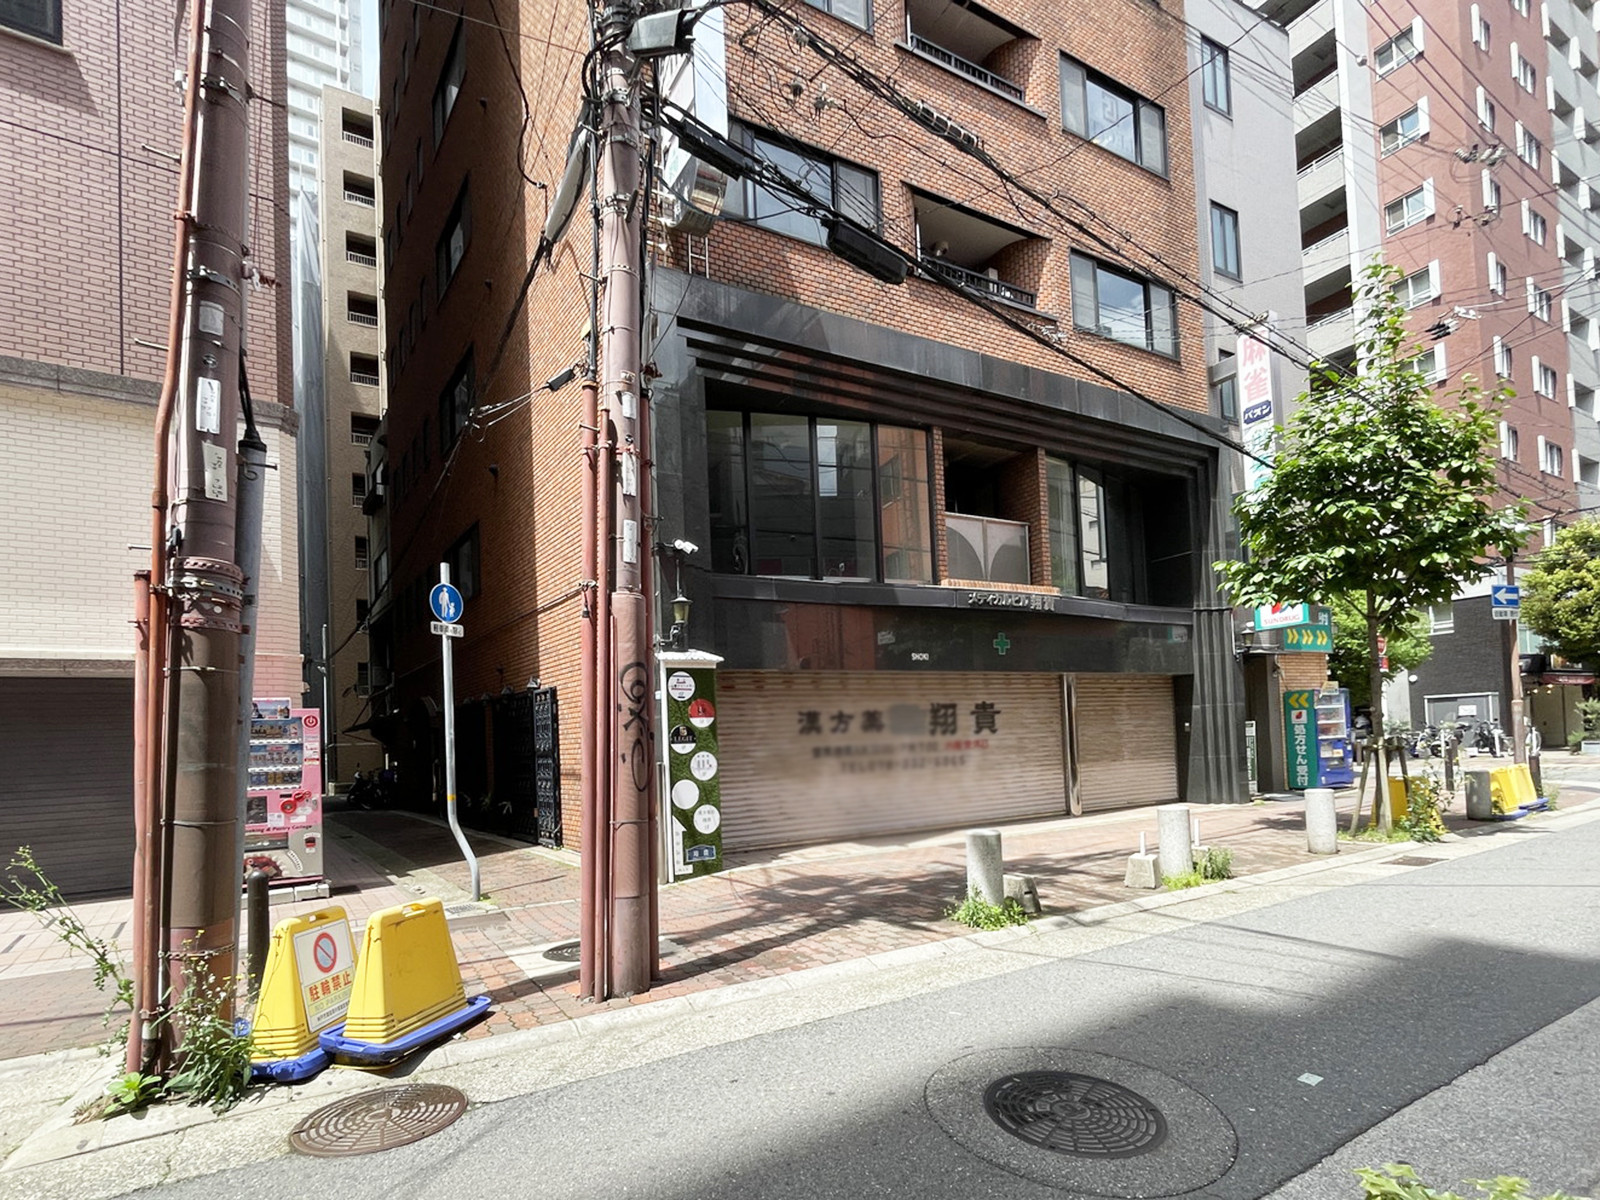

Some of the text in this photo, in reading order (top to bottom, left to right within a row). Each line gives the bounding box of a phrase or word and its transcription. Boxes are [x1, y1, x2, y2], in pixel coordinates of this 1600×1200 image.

[1242, 331, 1269, 401] 麻雀
[1263, 614, 1300, 625] SUNDRUG
[1294, 724, 1308, 786] 処方せん受付
[308, 971, 353, 1002] 駐輪禁止
